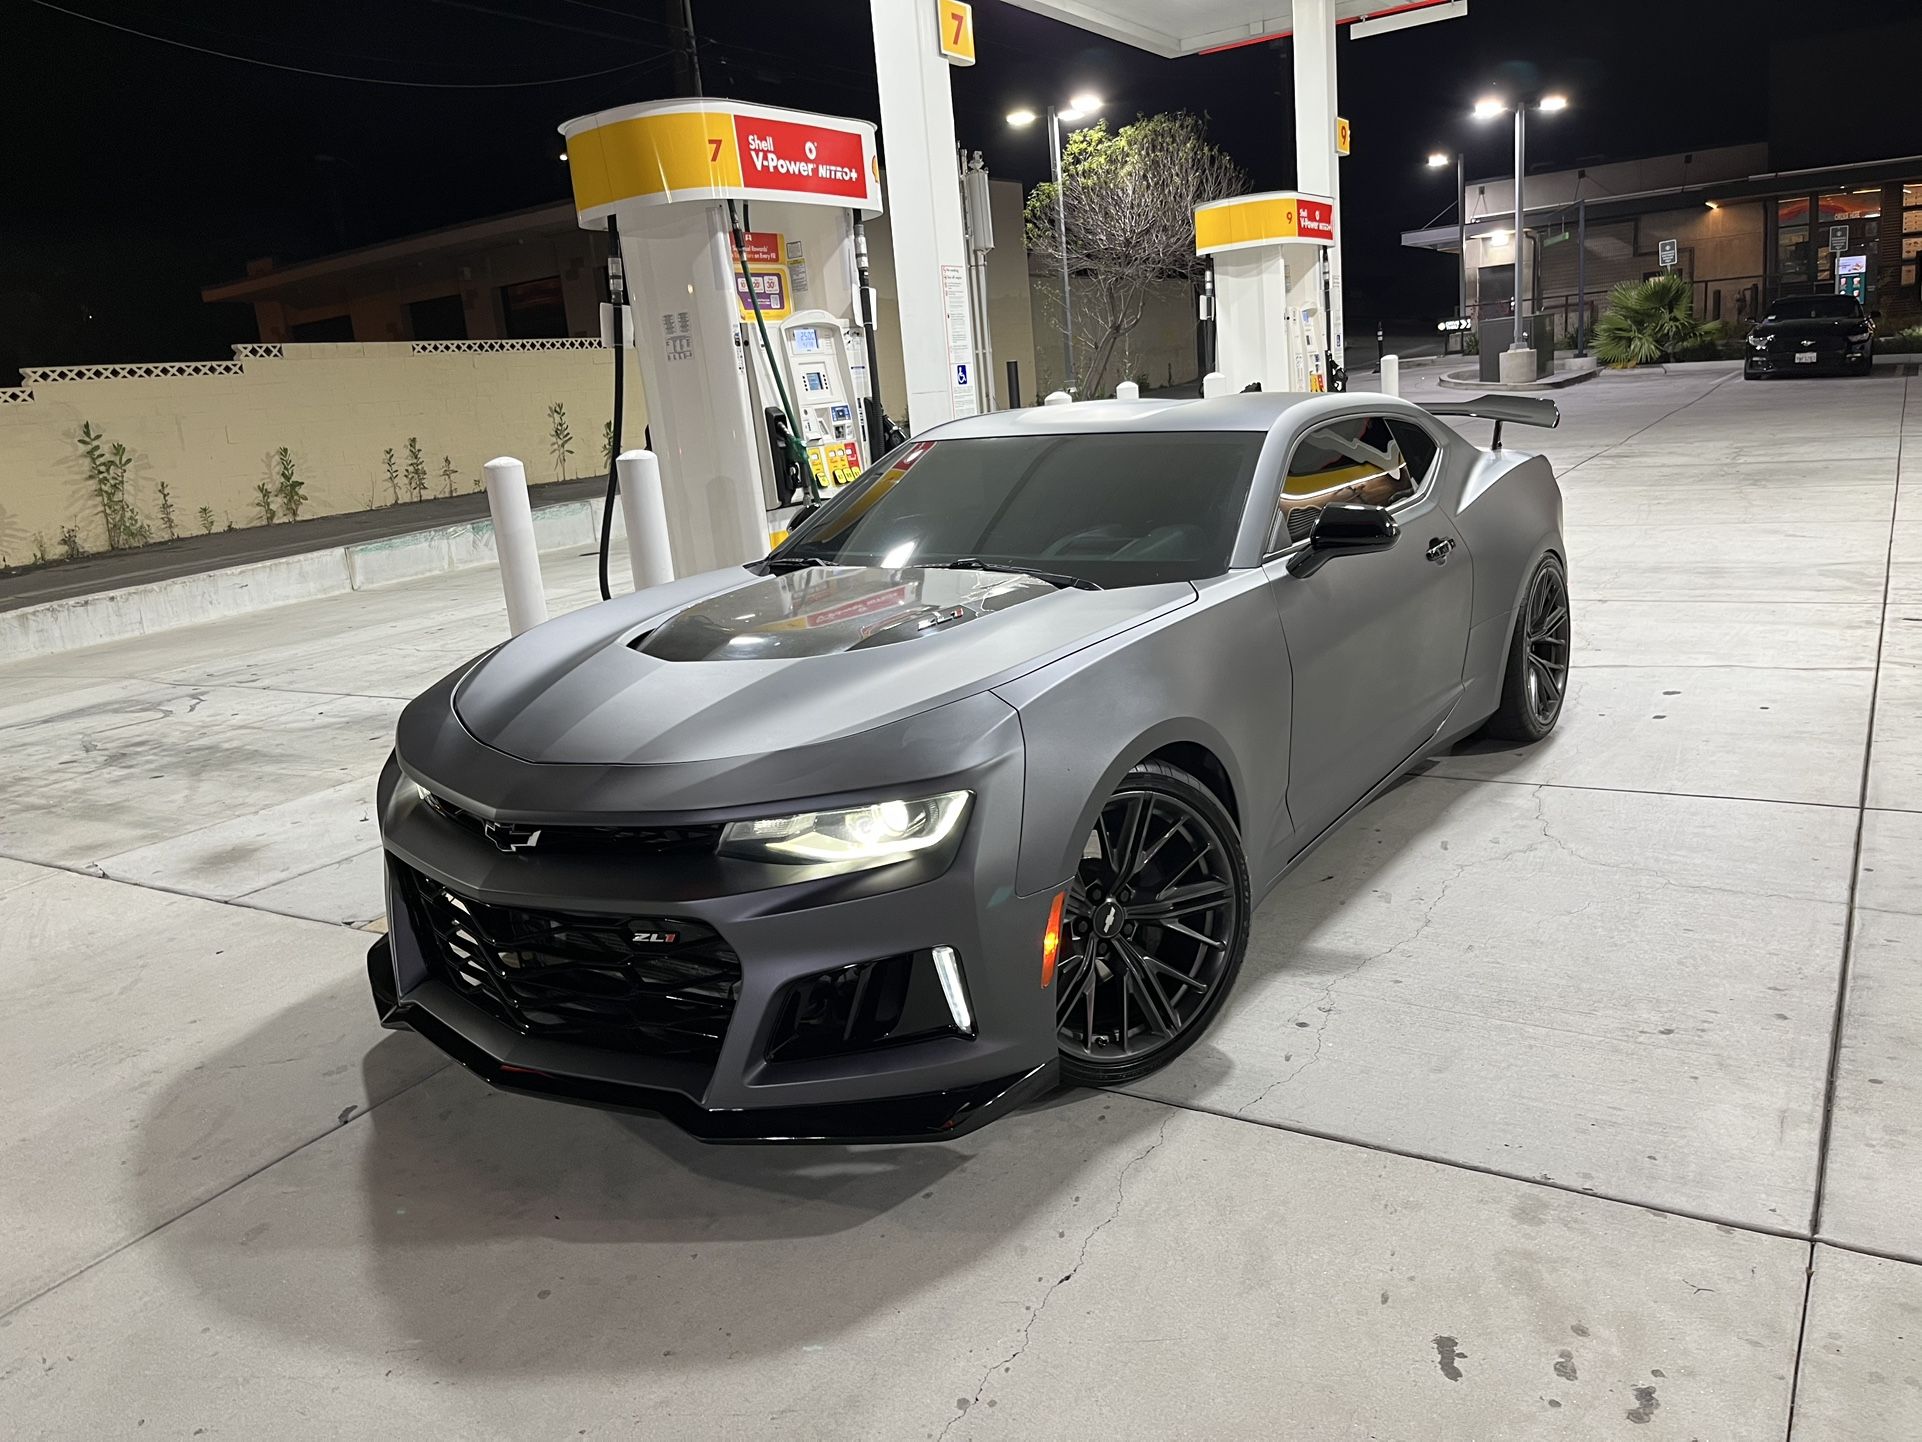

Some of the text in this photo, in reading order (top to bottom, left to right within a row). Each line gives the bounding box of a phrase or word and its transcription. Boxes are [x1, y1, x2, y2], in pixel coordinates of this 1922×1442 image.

[951, 13, 964, 45] 7
[748, 135, 774, 152] Shell
[1341, 126, 1347, 145] 9
[708, 139, 722, 162] 7
[750, 150, 815, 177] V-Power
[1287, 212, 1292, 224] 9
[632, 933, 676, 942] ZL1
